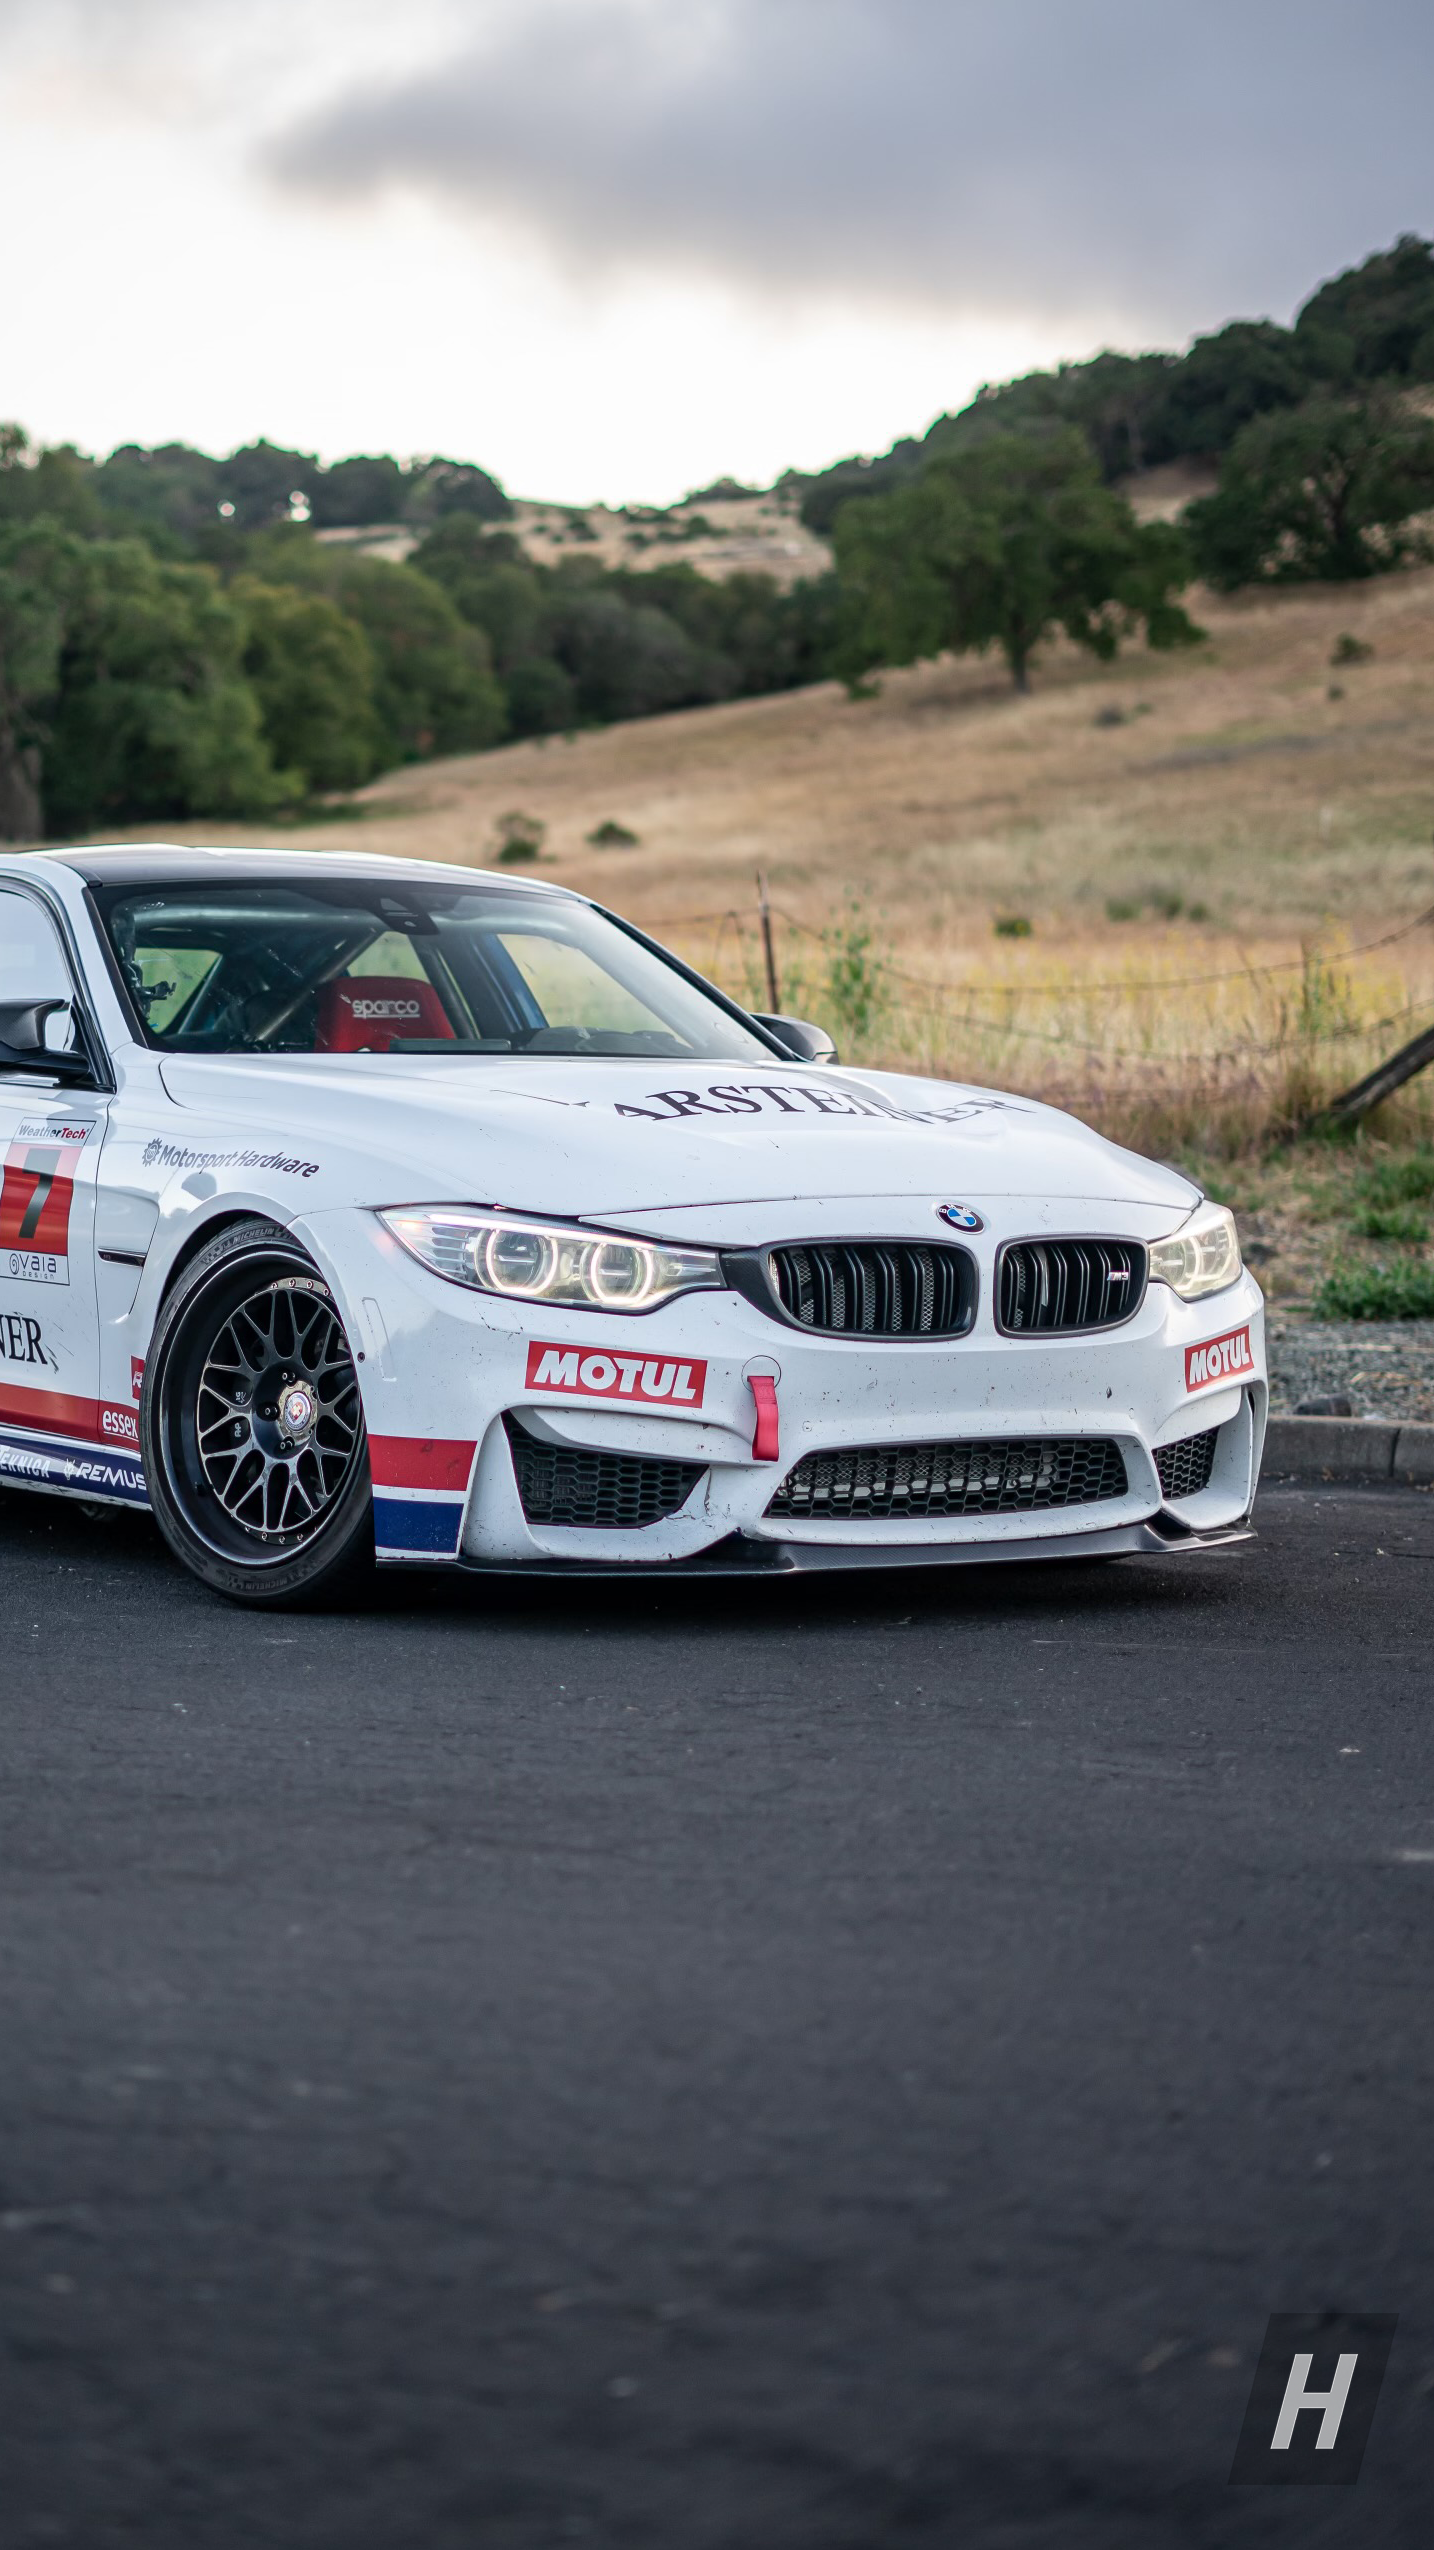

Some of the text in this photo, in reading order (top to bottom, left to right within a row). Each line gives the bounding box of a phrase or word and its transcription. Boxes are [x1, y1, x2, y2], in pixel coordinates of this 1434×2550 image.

[352, 999, 419, 1019] sparco
[158, 1144, 320, 1178] Motorsport Hardware
[18, 1147, 63, 1239] 7
[232, 1227, 275, 1245] MICHELIN
[533, 1349, 697, 1400] MOTUL
[1189, 1333, 1251, 1386] MOTUL
[102, 1410, 139, 1439] essex
[75, 1462, 147, 1491] REMUS
